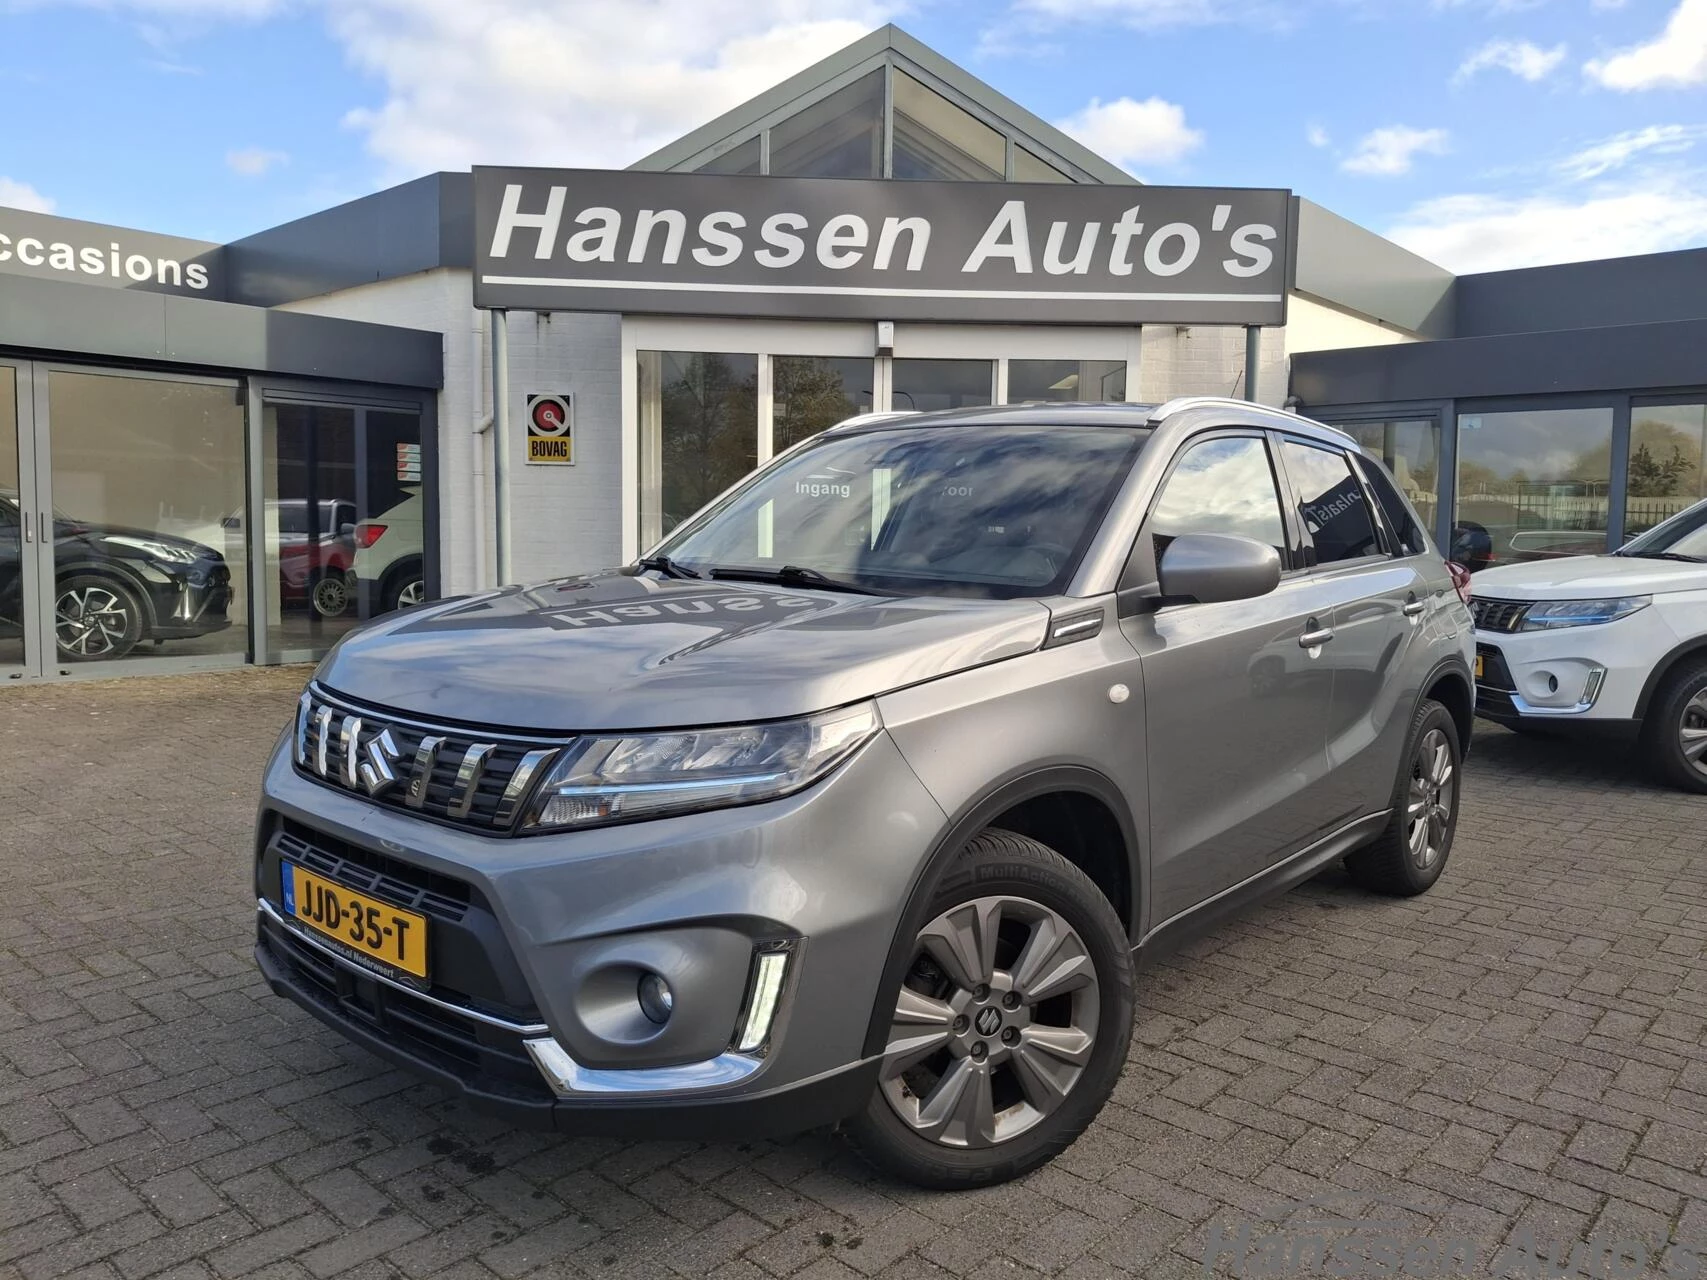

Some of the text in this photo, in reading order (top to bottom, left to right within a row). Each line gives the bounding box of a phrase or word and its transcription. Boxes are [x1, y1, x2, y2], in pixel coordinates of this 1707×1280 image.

[489, 184, 1278, 278] Hanssen Auto's
[532, 440, 567, 457] BOVAG
[795, 481, 850, 498] Ingang
[302, 880, 411, 961] JJD-35-T
